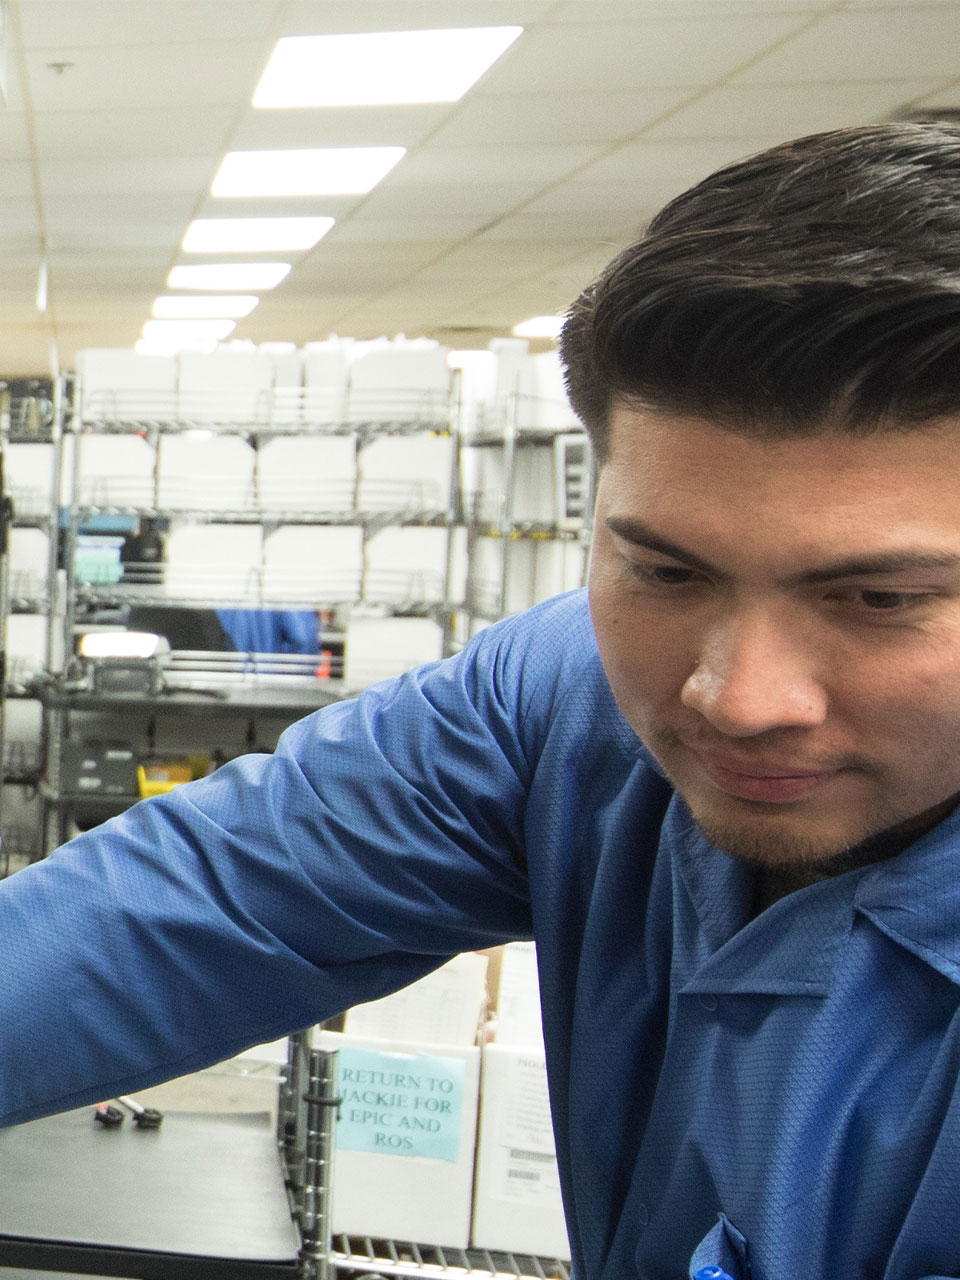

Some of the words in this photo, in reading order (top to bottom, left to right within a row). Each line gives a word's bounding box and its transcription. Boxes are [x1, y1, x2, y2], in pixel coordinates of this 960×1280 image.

[342, 1067, 420, 1089] RETURN
[428, 1077, 454, 1095] TO
[414, 1092, 453, 1115] FOR
[350, 1108, 390, 1127] EPIC
[400, 1116, 441, 1134] AND
[374, 1132, 414, 1150] ROS
